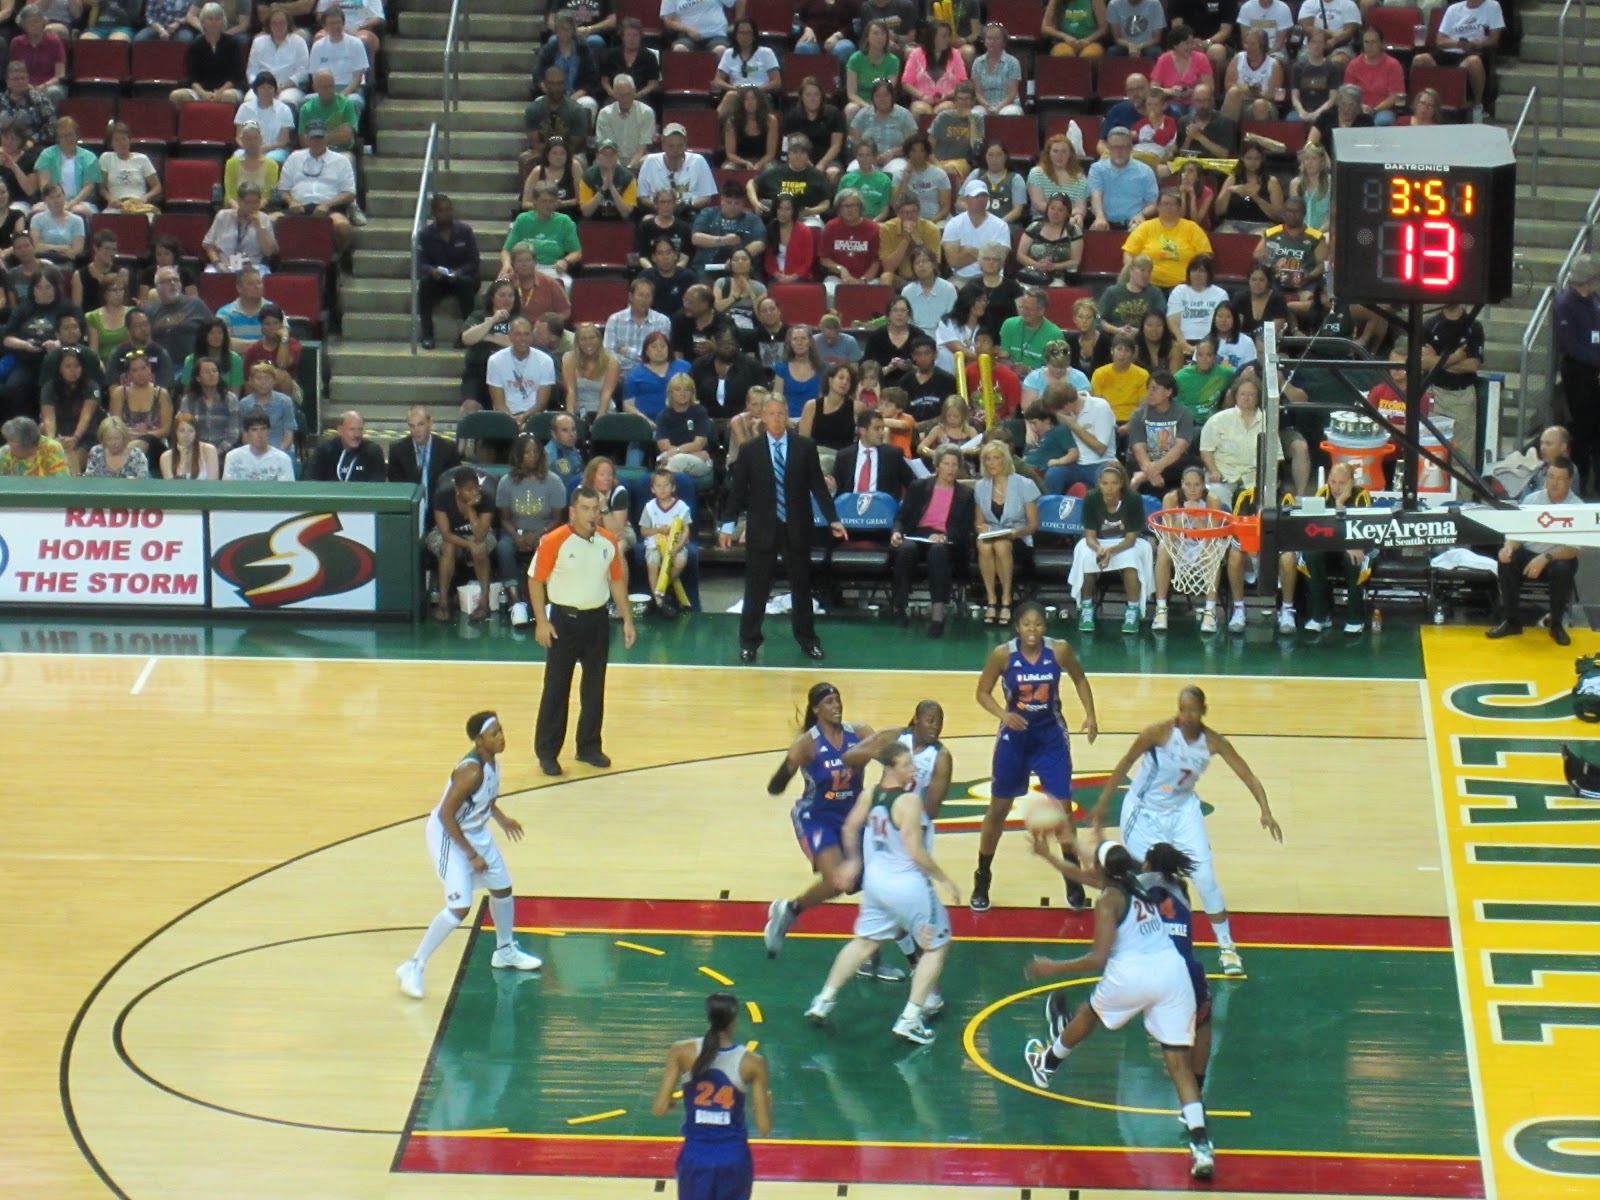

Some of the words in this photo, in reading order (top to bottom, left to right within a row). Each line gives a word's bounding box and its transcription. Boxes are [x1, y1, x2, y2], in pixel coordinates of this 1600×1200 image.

[1384, 163, 1450, 172] DAKTRONICS
[1391, 177, 1476, 216] 3:51
[1404, 221, 1455, 286] 13
[64, 506, 164, 528] RADIO
[1041, 521, 1065, 529] EXPECT
[1345, 518, 1458, 544] KeyArena
[1384, 538, 1394, 547] at
[1395, 537, 1426, 546] Seattle
[1427, 536, 1457, 545] Center
[37, 538, 132, 561] HOME
[140, 540, 183, 561] OF
[15, 571, 79, 593] THE
[87, 572, 199, 594] STORM
[1177, 768, 1193, 787] 7
[693, 1080, 735, 1110] 24
